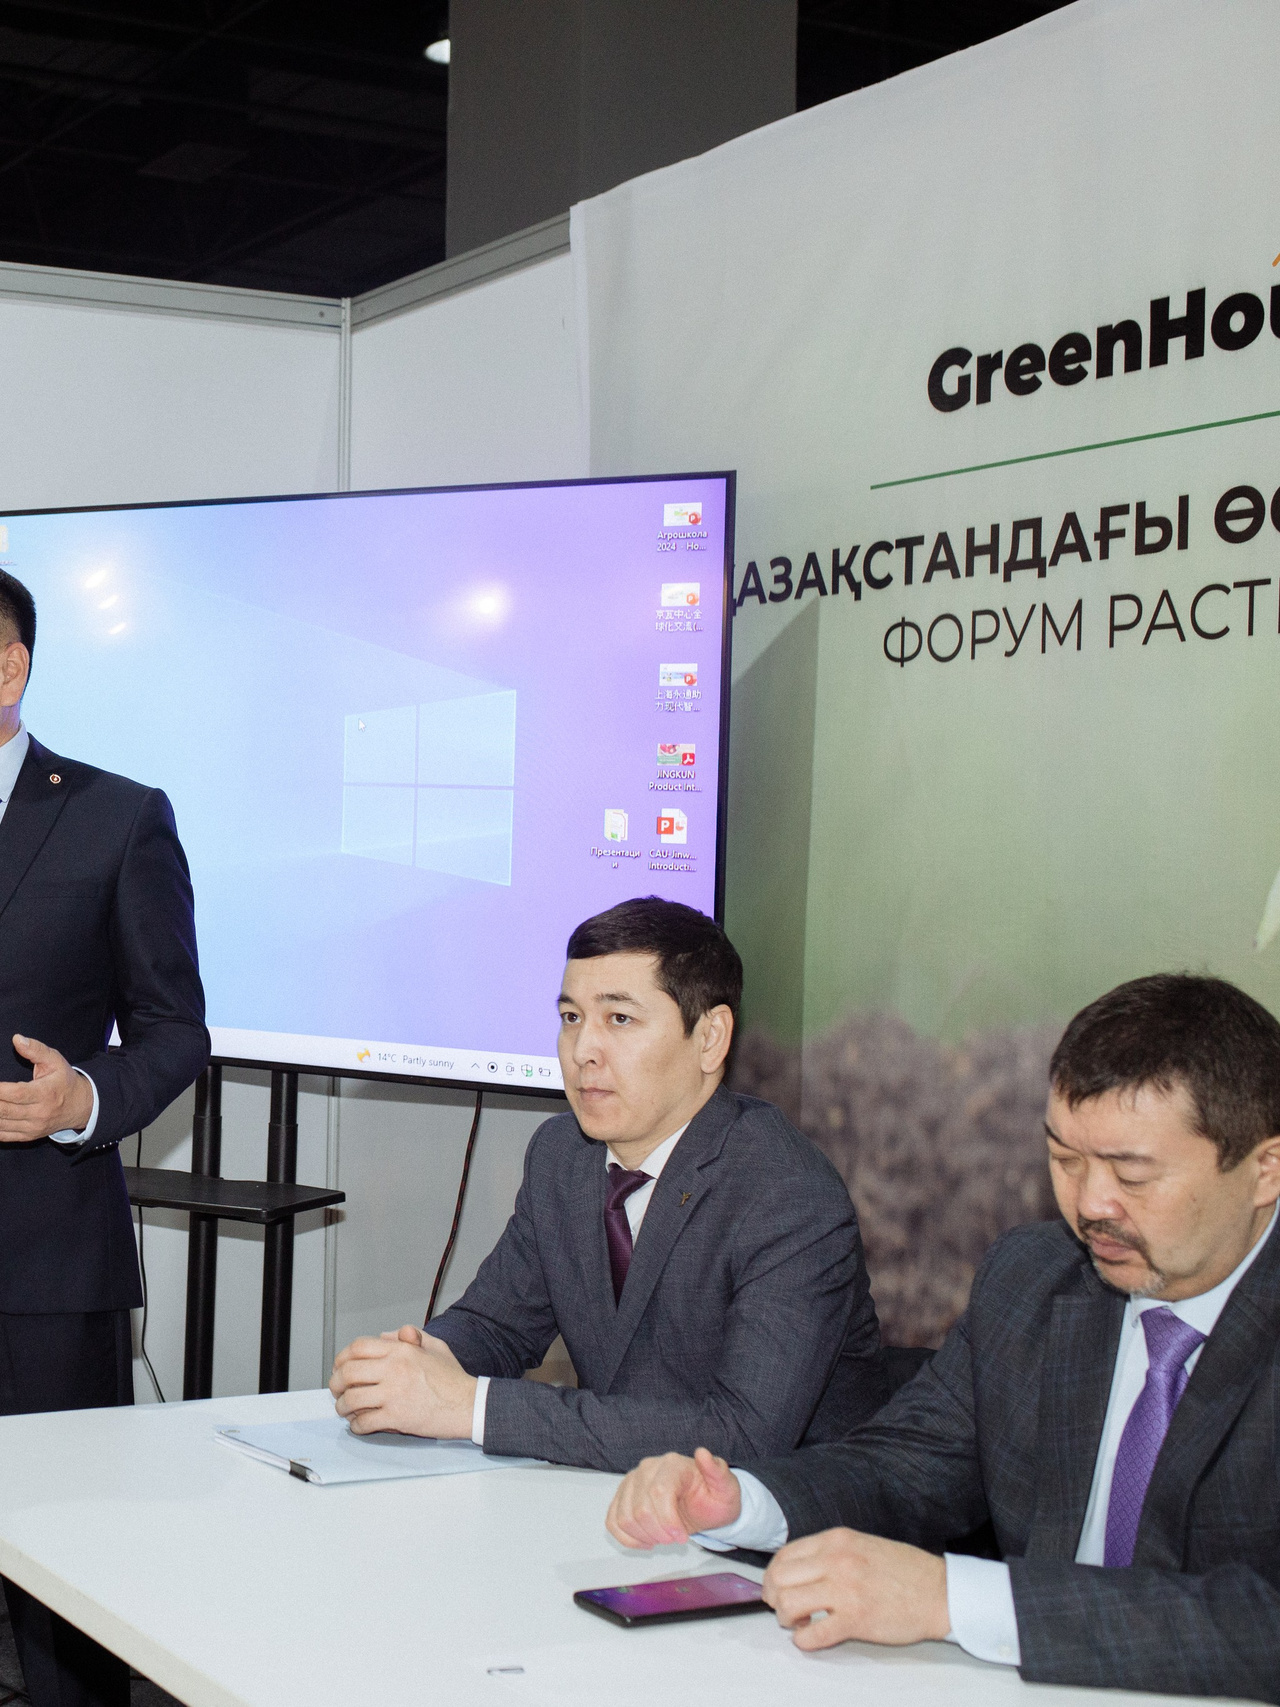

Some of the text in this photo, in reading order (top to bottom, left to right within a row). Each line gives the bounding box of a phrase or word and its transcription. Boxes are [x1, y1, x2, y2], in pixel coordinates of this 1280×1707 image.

[927, 283, 1280, 413] GreenHo
[657, 531, 708, 541] Агрошкола
[657, 542, 677, 551] 2024
[733, 485, 1280, 617] АЗАҚСТАНДАҒЫ Ө
[882, 577, 1280, 668] ФОРУМ РАСТ
[656, 769, 696, 779] JINGKUN
[649, 782, 682, 791] Product
[378, 1052, 455, 1070] 14°C Partly sunny
